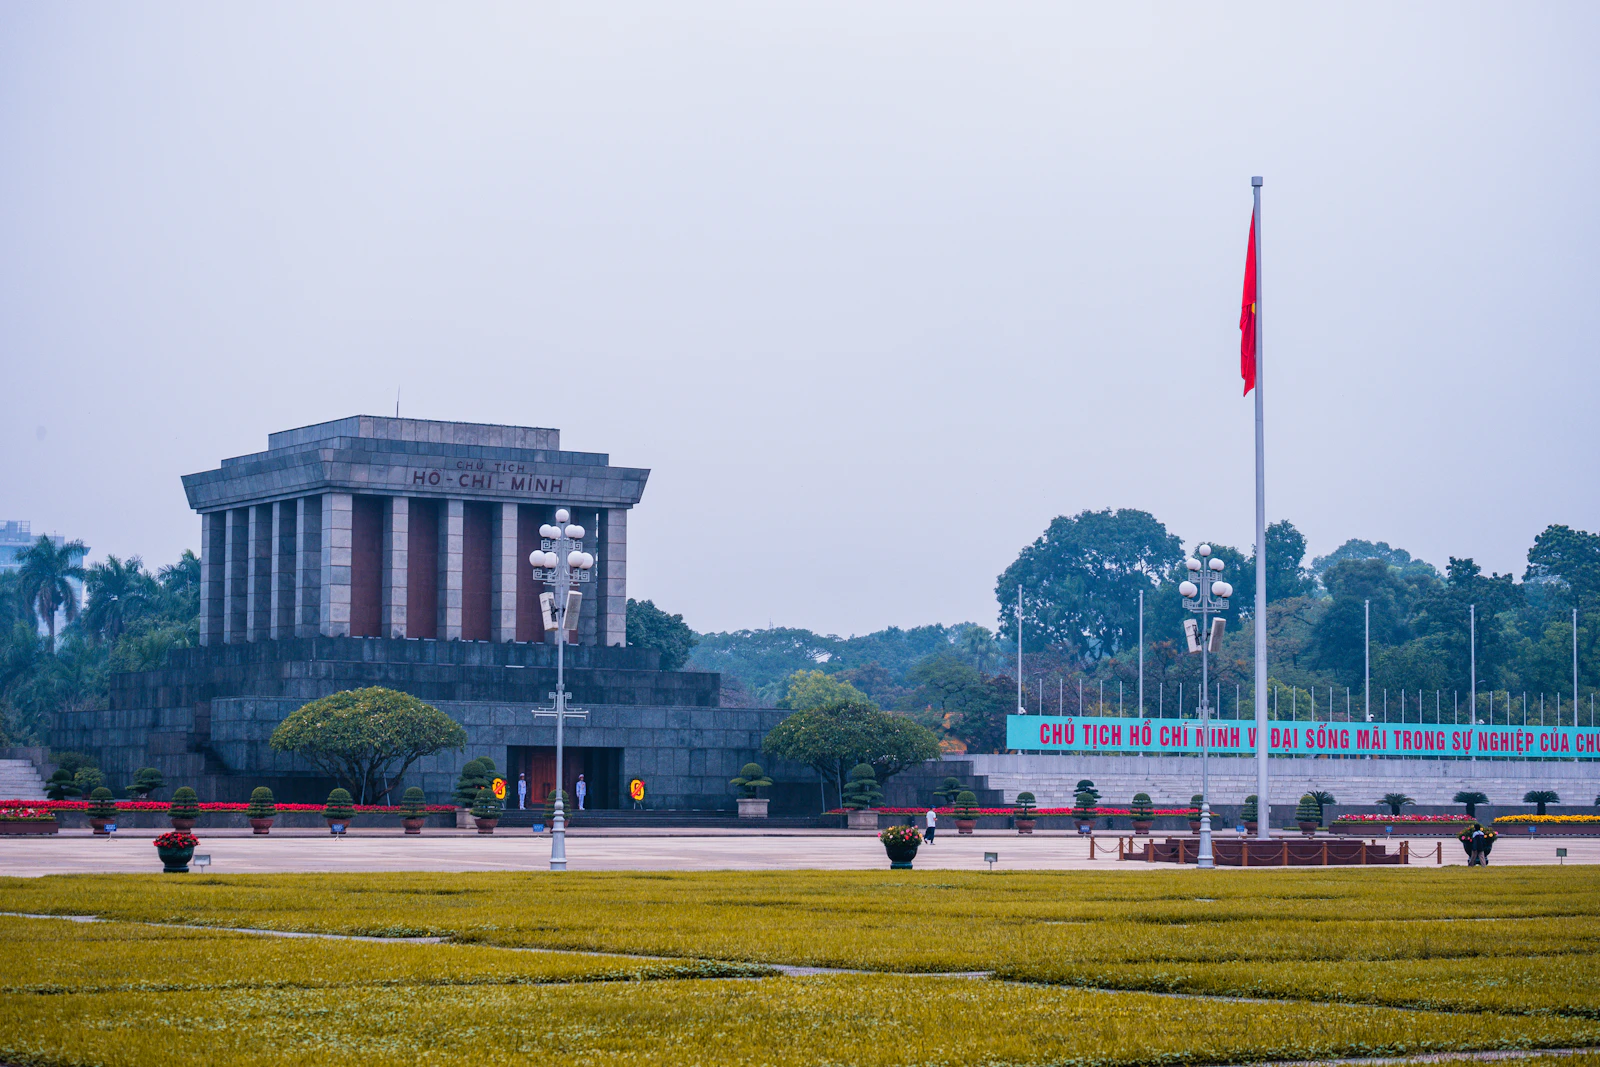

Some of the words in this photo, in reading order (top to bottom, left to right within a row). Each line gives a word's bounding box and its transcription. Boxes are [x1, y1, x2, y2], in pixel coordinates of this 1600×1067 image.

[1040, 717, 1075, 745] CHỦ
[1082, 724, 1121, 749] TỊCH
[1129, 719, 1152, 746] HỒ
[1160, 721, 1188, 747] CHÍ
[1270, 727, 1298, 752] ĐẠI
[1305, 723, 1349, 749] SỐNG
[1356, 725, 1387, 750] MÃI
[1394, 729, 1446, 751] TRONG
[1452, 728, 1473, 754] SỰ
[1478, 728, 1534, 755] NGHIỆP
[1540, 727, 1570, 752] CỦA
